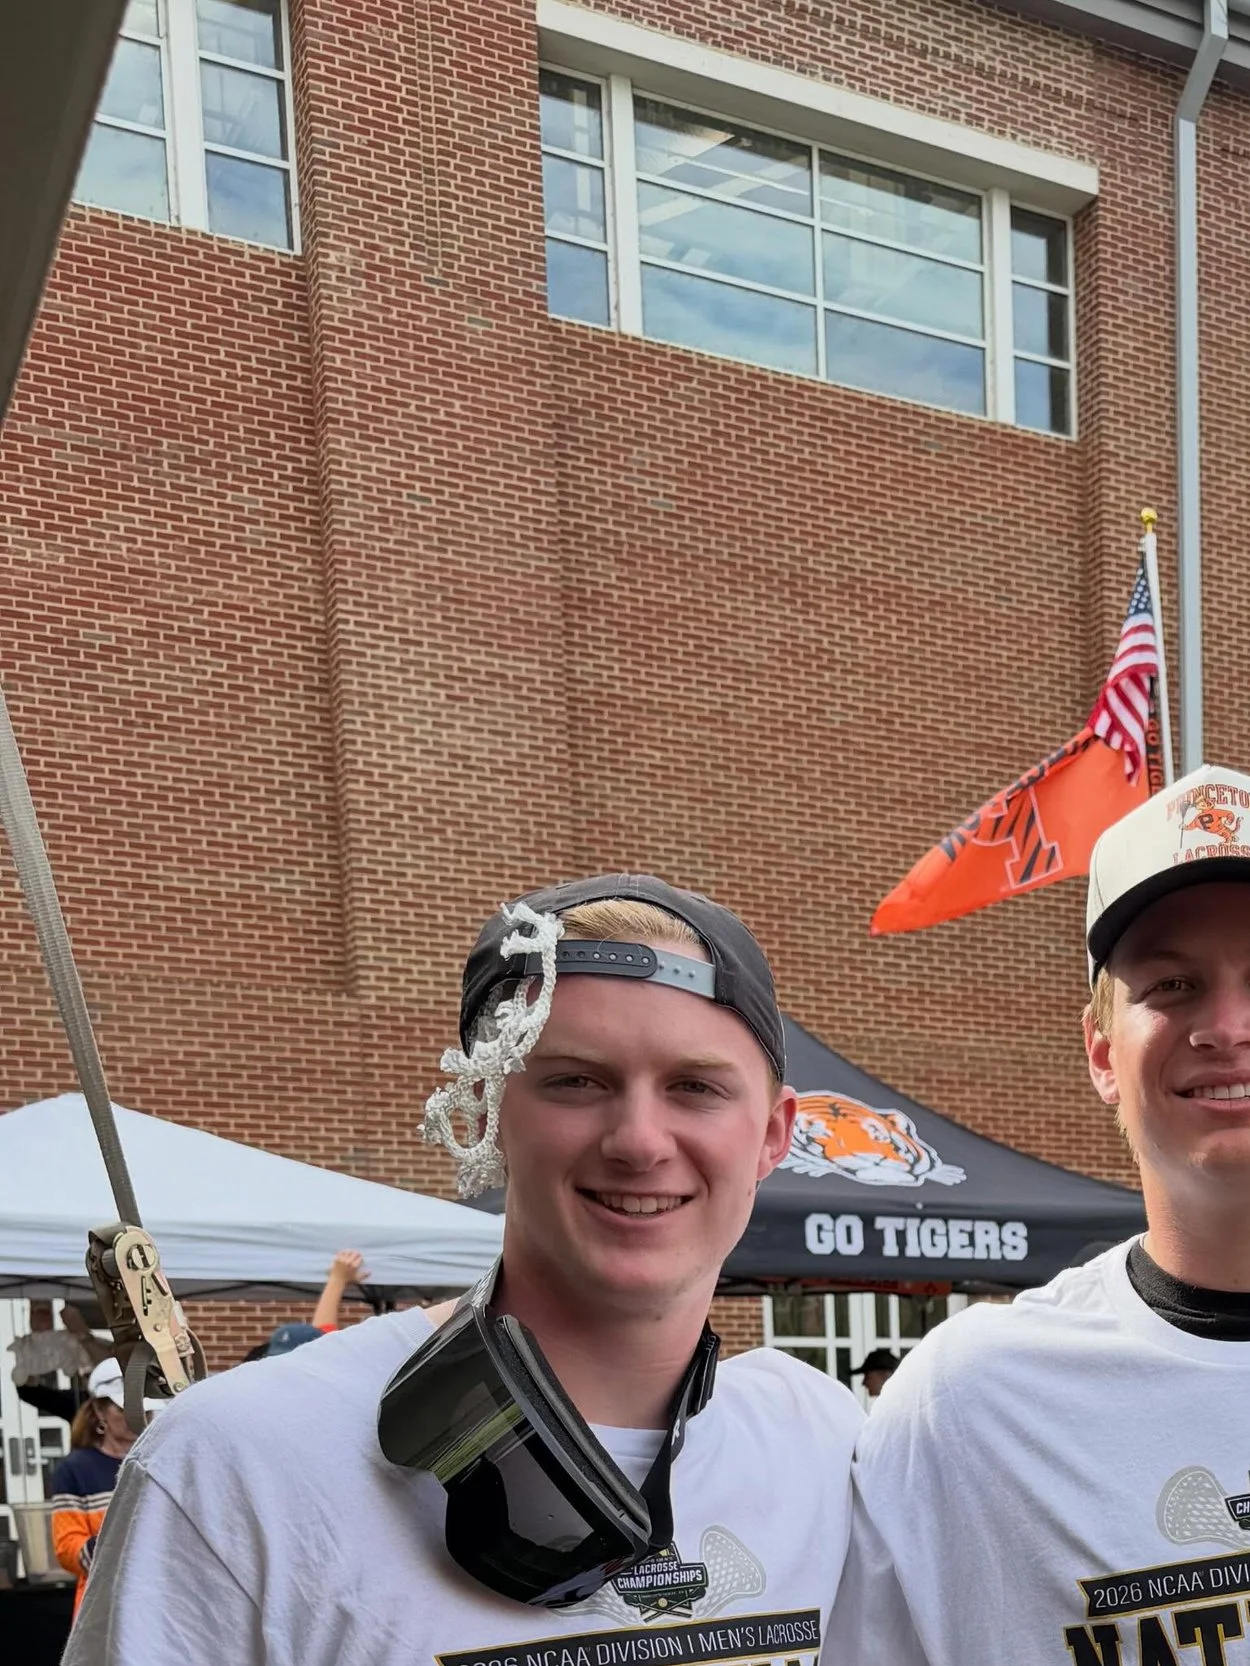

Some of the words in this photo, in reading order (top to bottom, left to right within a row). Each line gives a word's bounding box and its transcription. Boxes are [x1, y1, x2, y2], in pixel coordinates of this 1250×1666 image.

[804, 1213, 864, 1256] GO
[875, 1216, 1028, 1260] TIGERS
[617, 1569, 703, 1589] CHAMPIONSHIPS
[633, 1561, 678, 1576] LACROSSE
[1093, 1583, 1143, 1609] 2026
[1148, 1572, 1203, 1599] NCAA
[598, 1636, 684, 1666] DIVISION
[699, 1626, 755, 1652] MEN'S
[758, 1620, 819, 1646] LACROSSE
